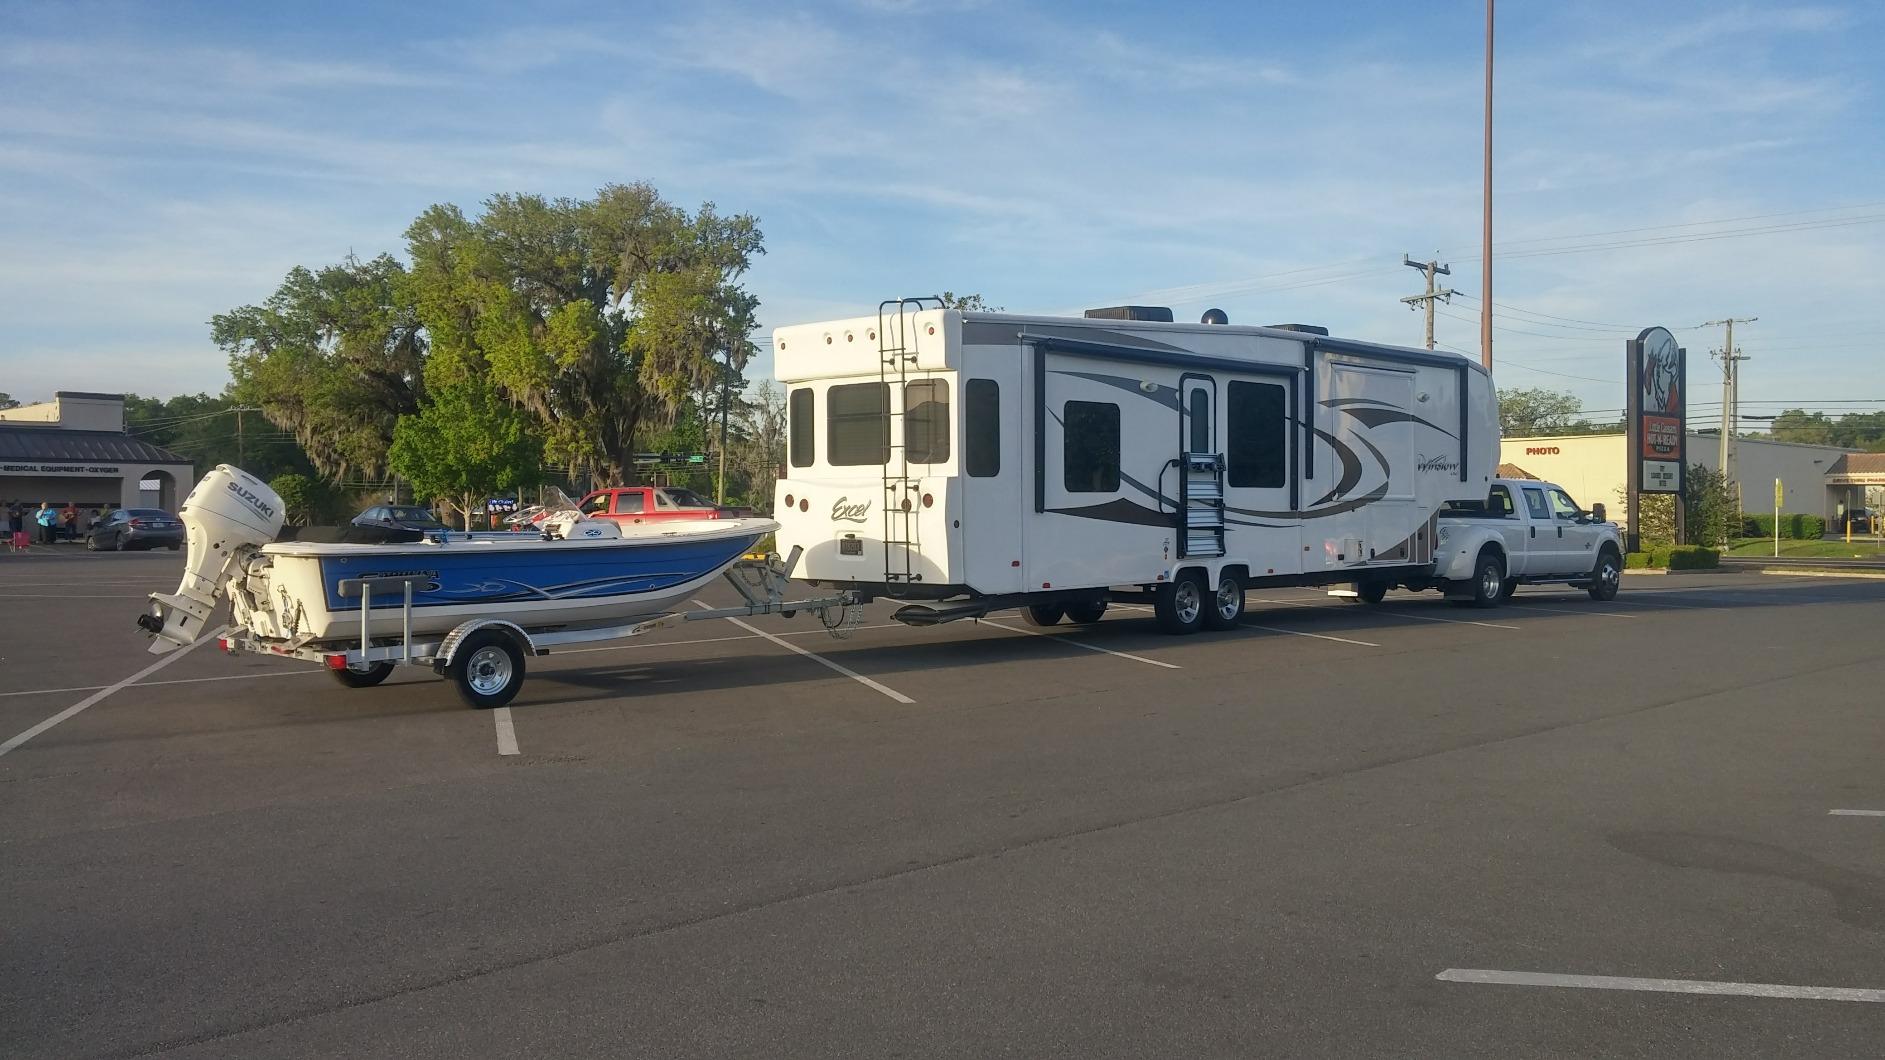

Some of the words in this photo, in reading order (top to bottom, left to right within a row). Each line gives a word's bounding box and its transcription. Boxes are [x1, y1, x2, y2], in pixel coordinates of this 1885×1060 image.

[1525, 447, 1561, 456] PHOTO
[227, 481, 274, 518] SUZUKI
[831, 496, 872, 522] Excel
